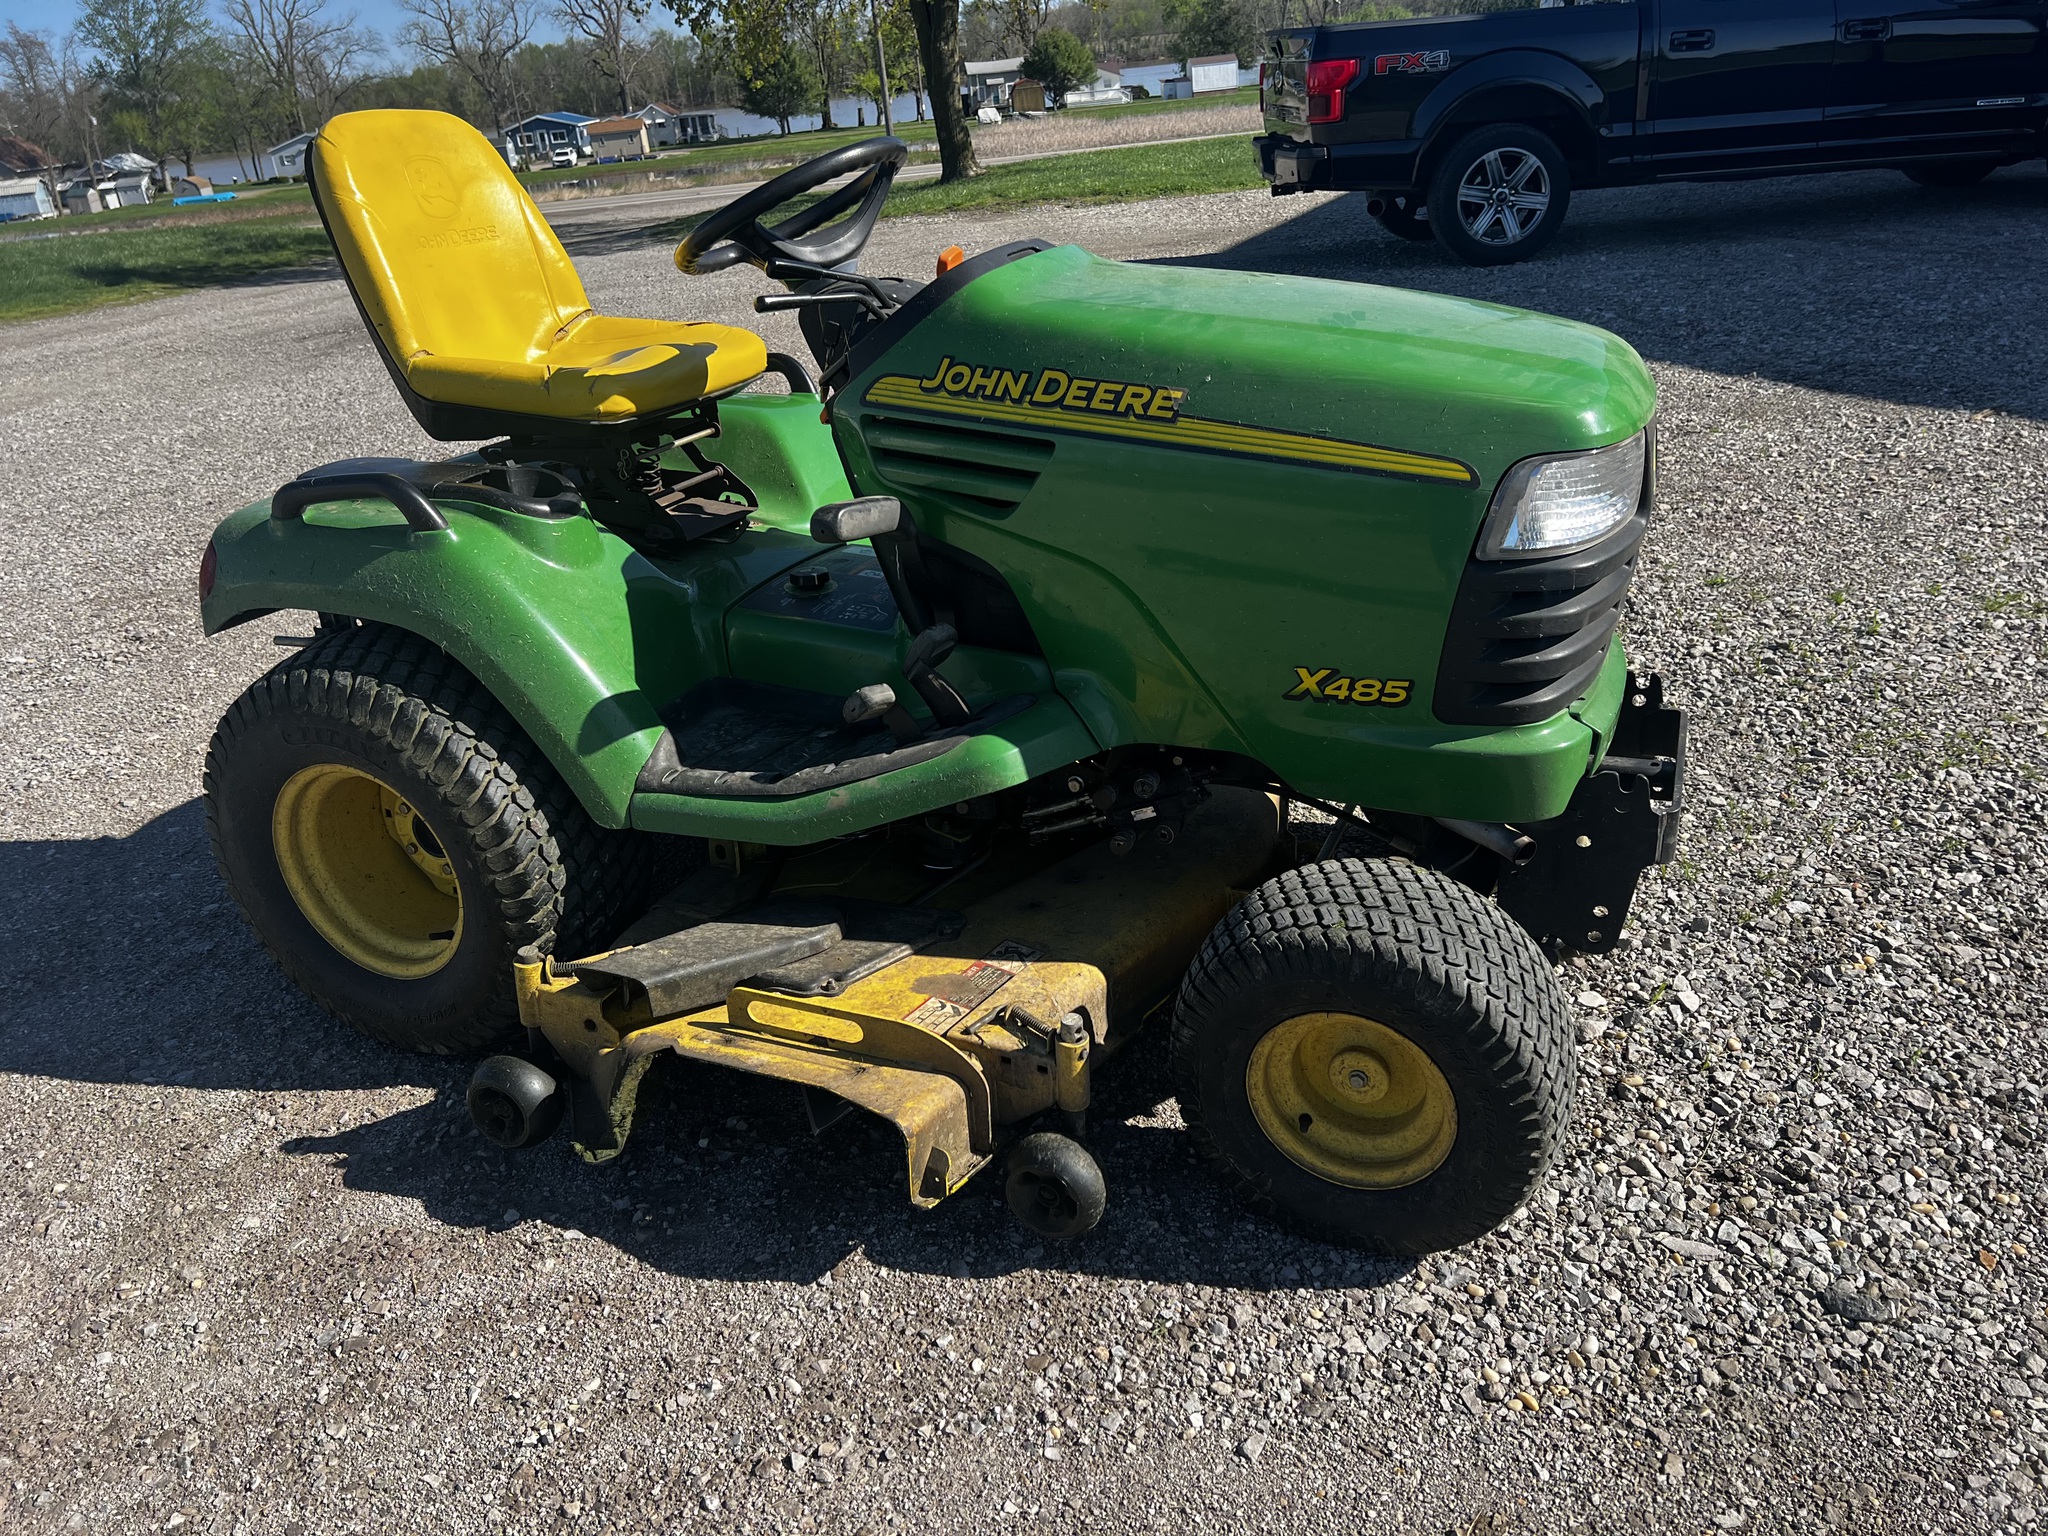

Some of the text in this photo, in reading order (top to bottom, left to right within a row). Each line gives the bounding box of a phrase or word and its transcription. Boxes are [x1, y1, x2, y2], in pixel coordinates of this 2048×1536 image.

[1375, 50, 1450, 75] FX4
[448, 225, 500, 244] DEERE
[921, 356, 1185, 420] JOHN DEERE
[1286, 667, 1411, 704] X485
